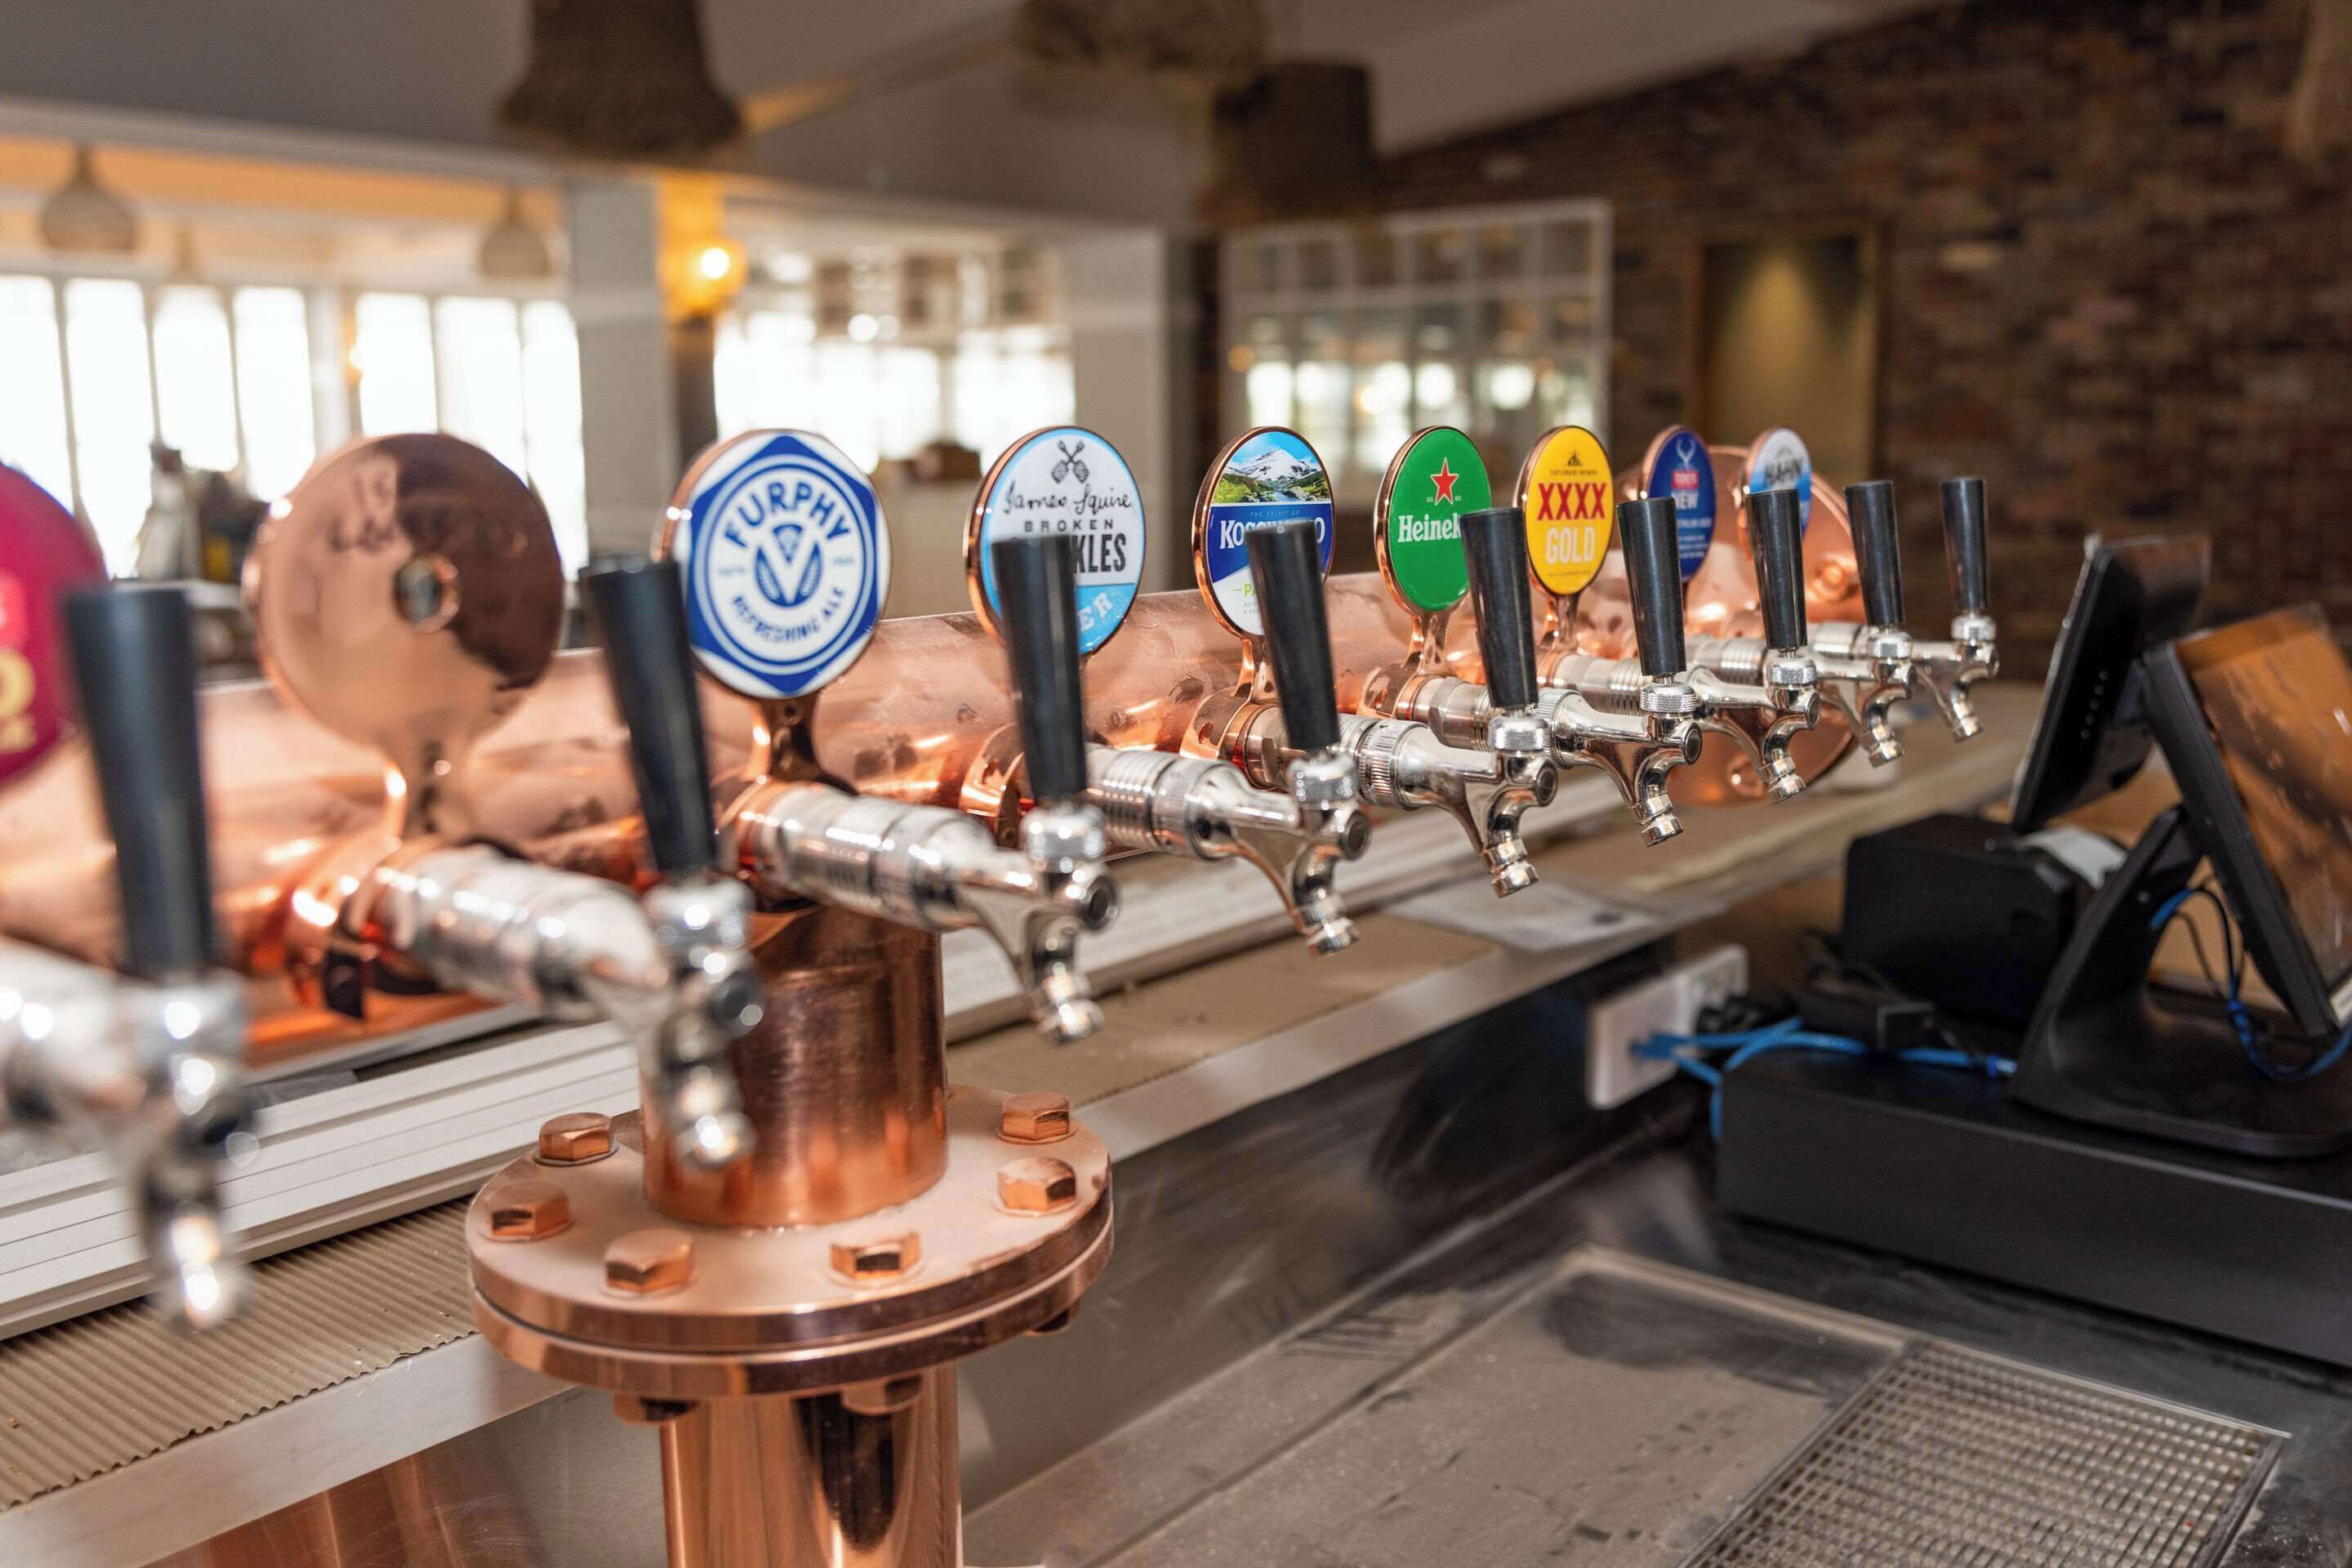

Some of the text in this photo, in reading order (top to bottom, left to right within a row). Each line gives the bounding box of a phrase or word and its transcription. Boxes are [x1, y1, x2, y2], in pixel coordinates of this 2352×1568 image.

[724, 482, 850, 549] FURPHY
[1003, 479, 1133, 514] James Squire
[1537, 483, 1607, 521] XXXX
[1023, 519, 1114, 532] BROKEN
[1397, 512, 1462, 543] Heinek
[1071, 533, 1126, 573] KLES
[1546, 526, 1597, 564] GOLD
